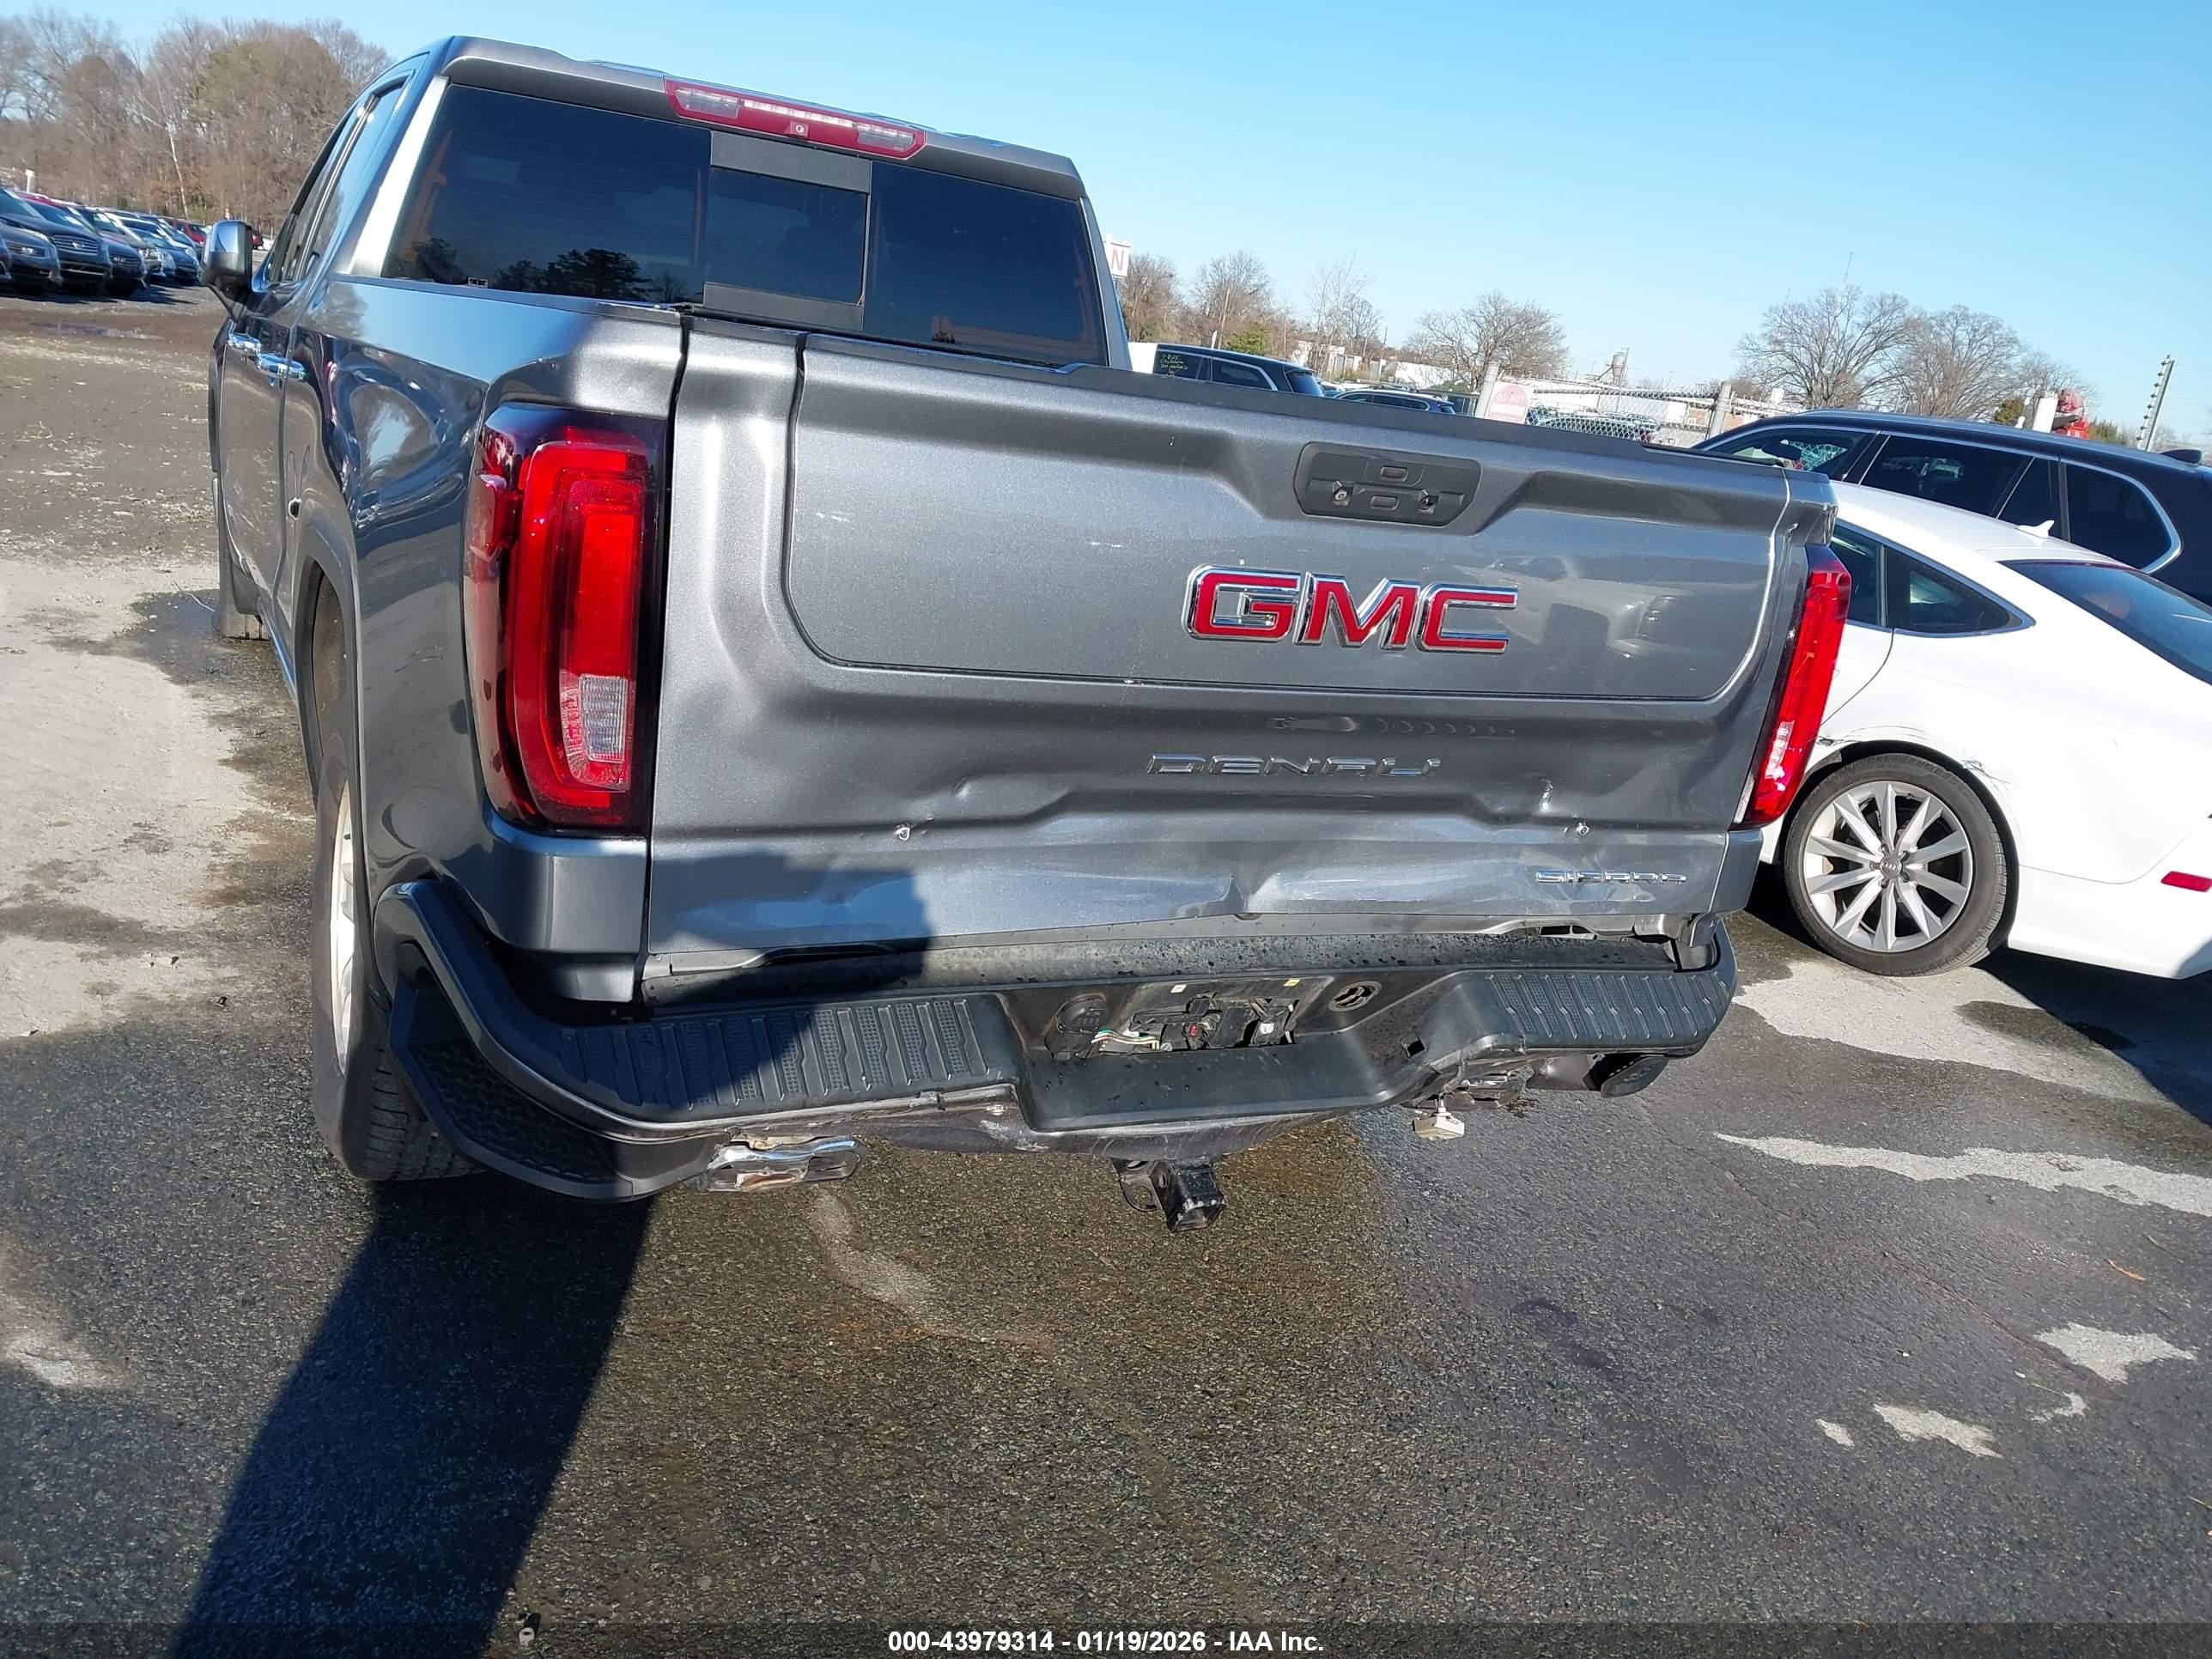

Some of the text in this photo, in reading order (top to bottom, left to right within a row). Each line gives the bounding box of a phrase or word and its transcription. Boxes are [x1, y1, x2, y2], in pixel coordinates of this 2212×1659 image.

[1497, 392, 1525, 404] DO NOT
[1182, 564, 1519, 654] GMC
[1146, 754, 1442, 777] DENALI
[1535, 870, 1687, 885] SIERRA
